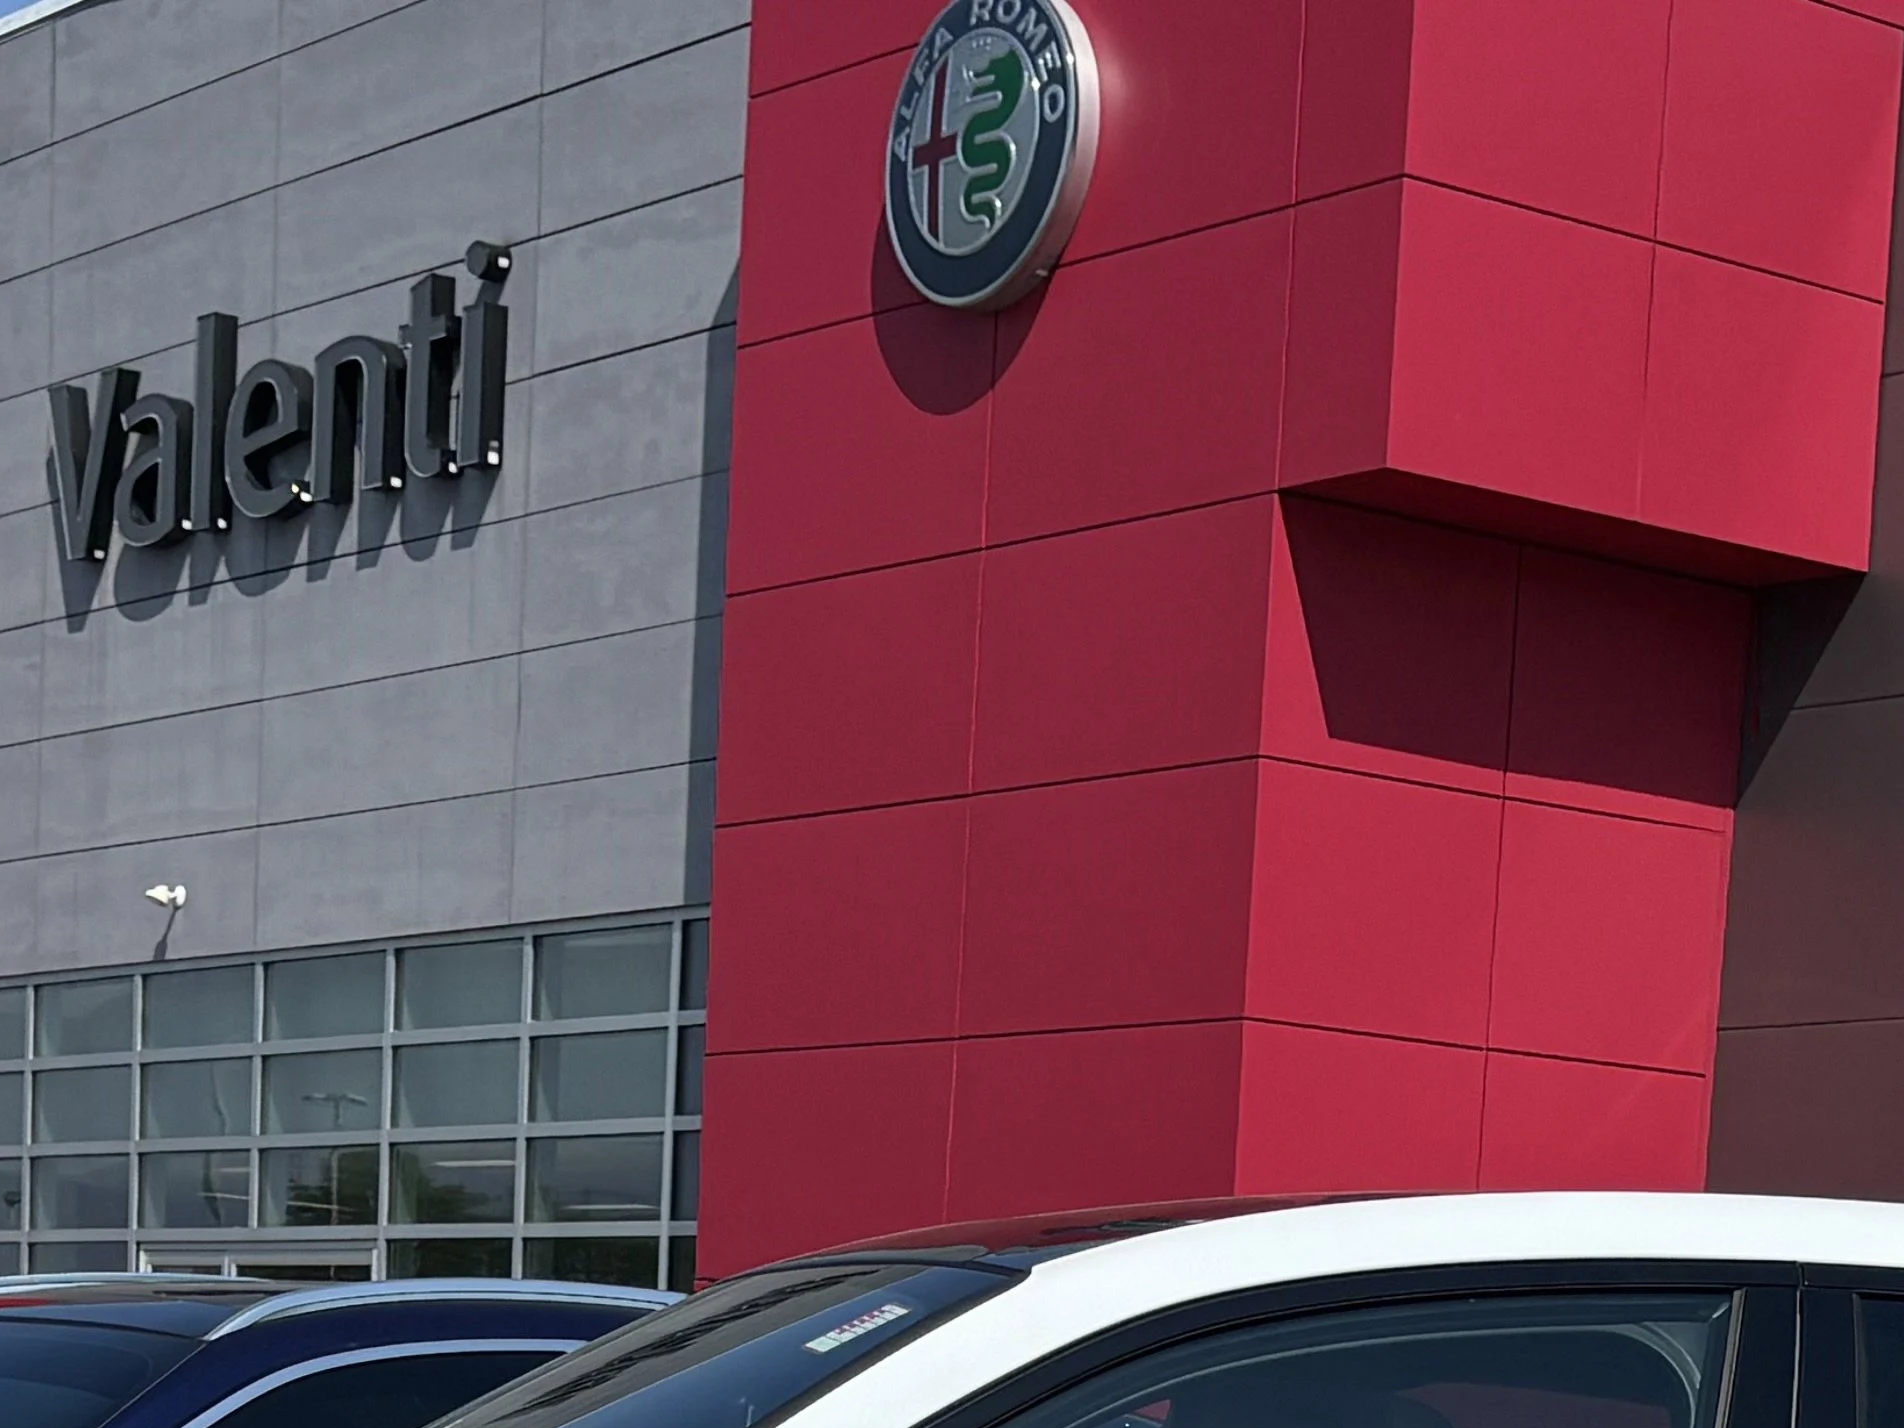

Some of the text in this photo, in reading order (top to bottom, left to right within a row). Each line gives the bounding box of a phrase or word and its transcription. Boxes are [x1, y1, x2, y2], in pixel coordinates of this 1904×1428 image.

[893, 0, 1065, 162] ALFA ROMEO
[47, 240, 512, 562] Valenti
